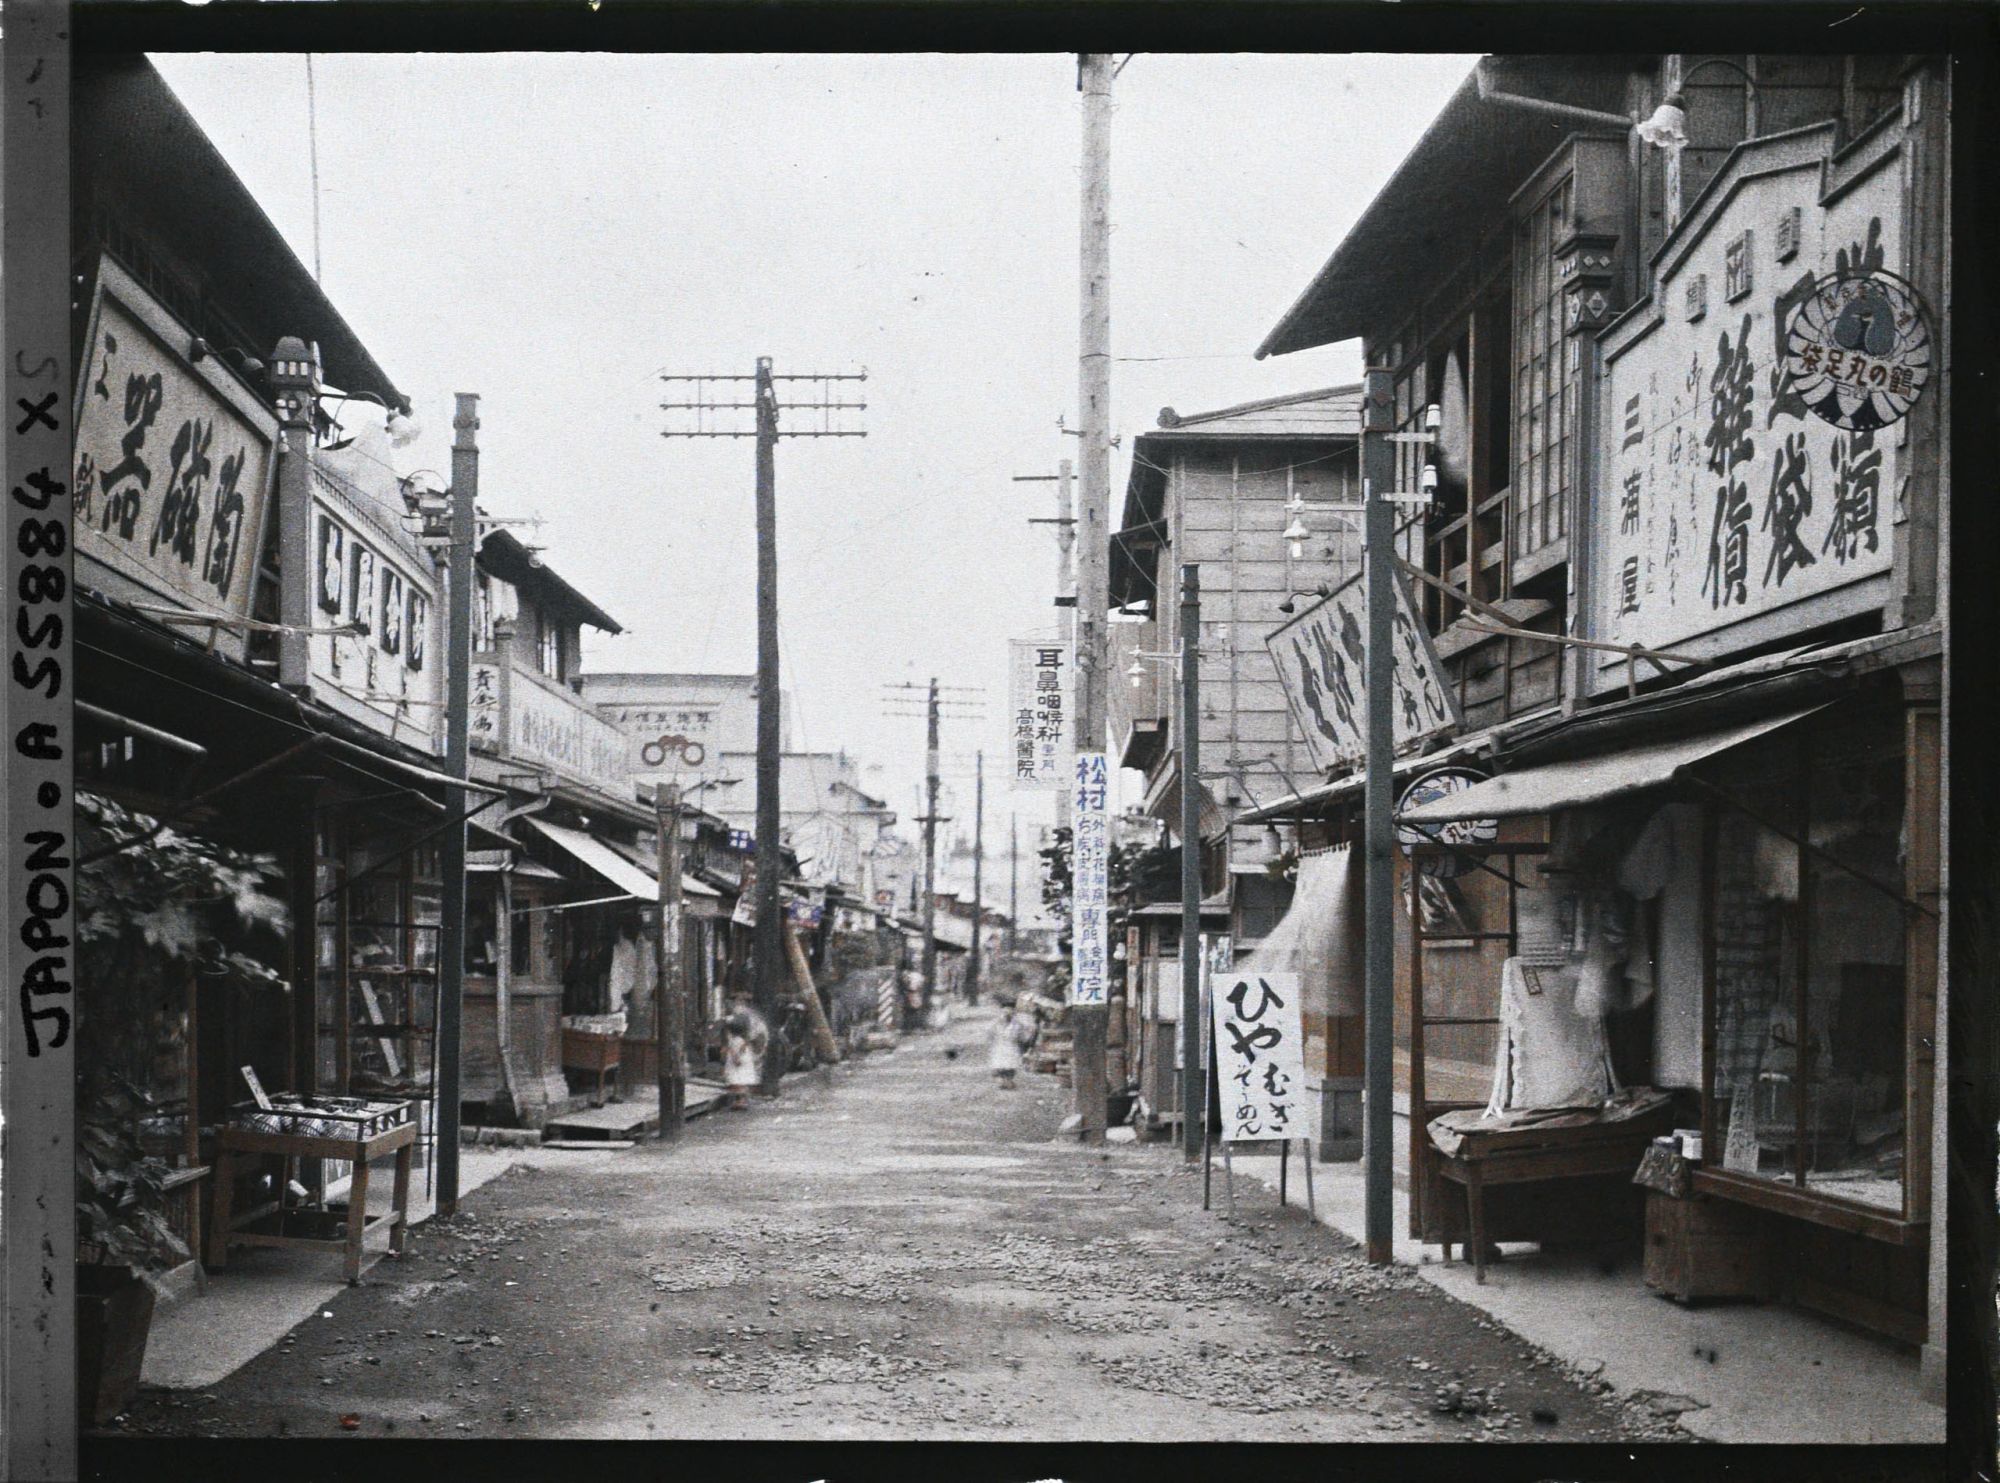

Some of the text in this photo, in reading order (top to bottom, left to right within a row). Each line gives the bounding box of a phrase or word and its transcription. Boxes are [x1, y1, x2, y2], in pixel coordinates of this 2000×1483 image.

[1615, 392, 1645, 621] 三浦屋
[14, 721, 64, 760] A
[1076, 756, 1107, 812] 松村
[19, 830, 72, 1058] JAPON
[1225, 977, 1285, 1065] ひや
